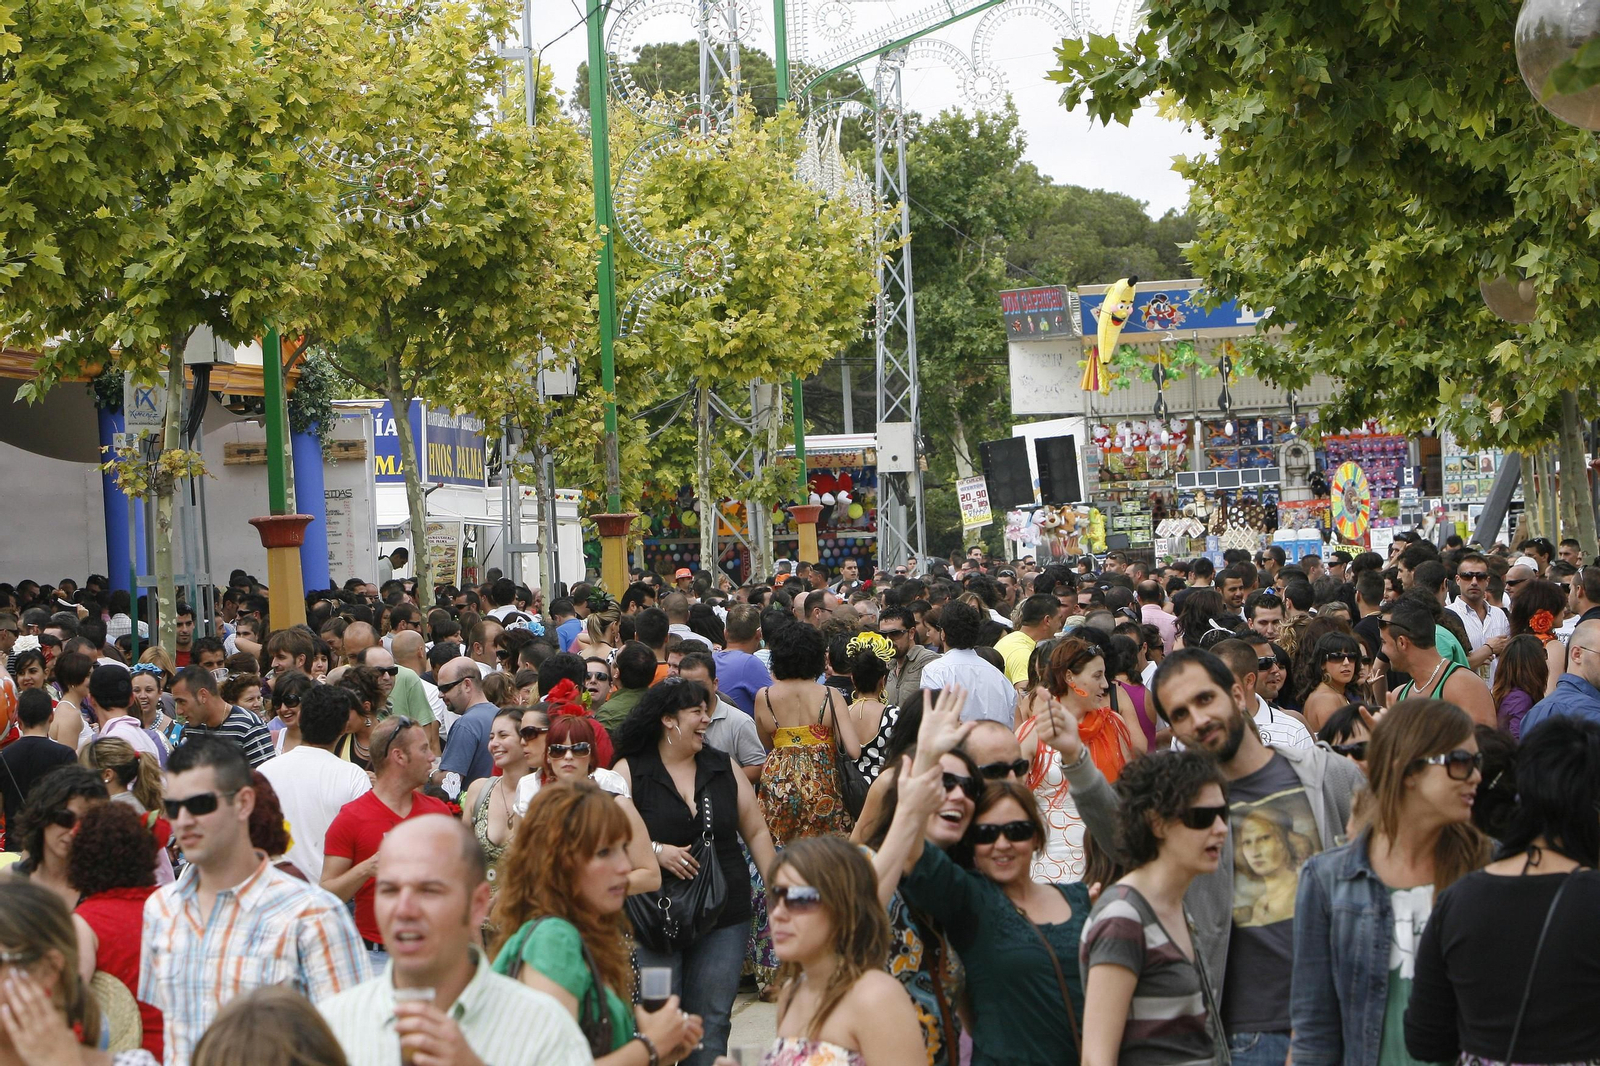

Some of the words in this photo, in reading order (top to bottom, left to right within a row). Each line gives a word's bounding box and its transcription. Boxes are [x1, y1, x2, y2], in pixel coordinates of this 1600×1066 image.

[428, 443, 455, 478] HNOS.
[456, 446, 484, 480] PALMA
[960, 493, 971, 502] 20
[976, 490, 987, 499] 90
